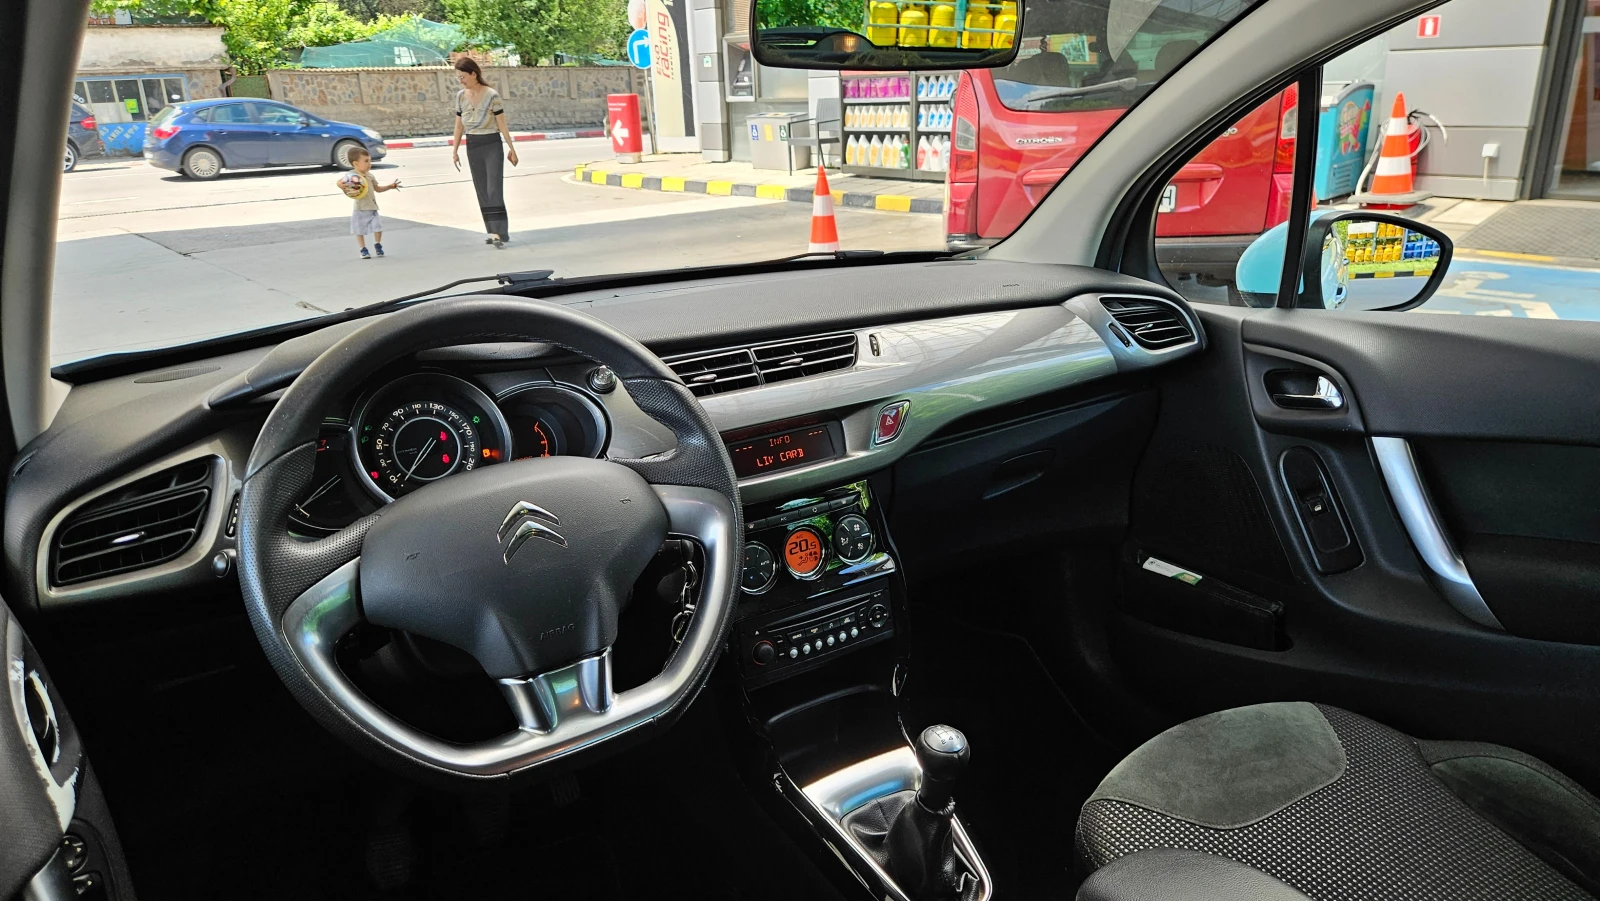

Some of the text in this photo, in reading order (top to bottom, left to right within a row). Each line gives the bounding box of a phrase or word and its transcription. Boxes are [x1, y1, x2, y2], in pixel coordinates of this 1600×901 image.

[657, 12, 670, 79] racing
[392, 408, 404, 417] 90
[429, 402, 444, 411] 130
[448, 410, 460, 420] 150
[381, 422, 390, 431] 70
[461, 422, 473, 436] 170
[376, 438, 383, 450] 50
[769, 435, 791, 447] INFO
[466, 457, 475, 471] 210
[389, 475, 399, 484] 10
[789, 538, 817, 555] 20.5
